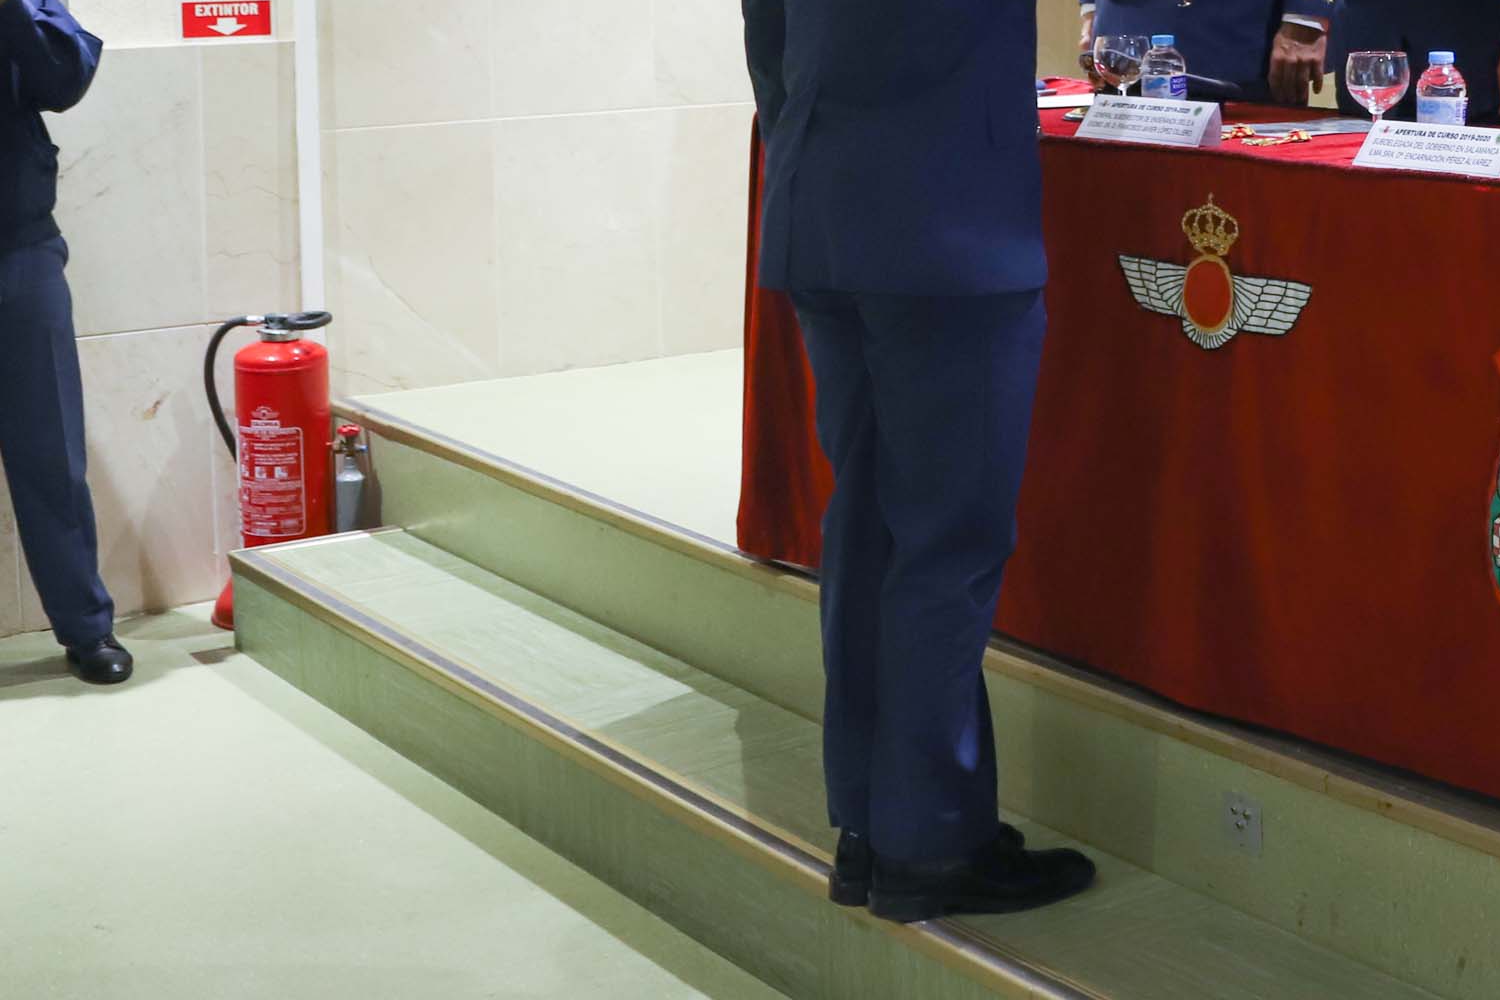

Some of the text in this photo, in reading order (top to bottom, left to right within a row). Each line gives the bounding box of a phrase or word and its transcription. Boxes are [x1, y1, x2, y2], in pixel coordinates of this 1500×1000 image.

[195, 3, 258, 17] EXTINTOR
[1394, 128, 1492, 142] APERTURA DE CURSO 2019-2020
[1372, 137, 1413, 148] SUBDELEGADA
[1413, 141, 1424, 150] DEL
[1425, 142, 1455, 152] GOBIERNO
[1455, 144, 1464, 153] EN
[1463, 145, 1499, 155] SALAMANCA
